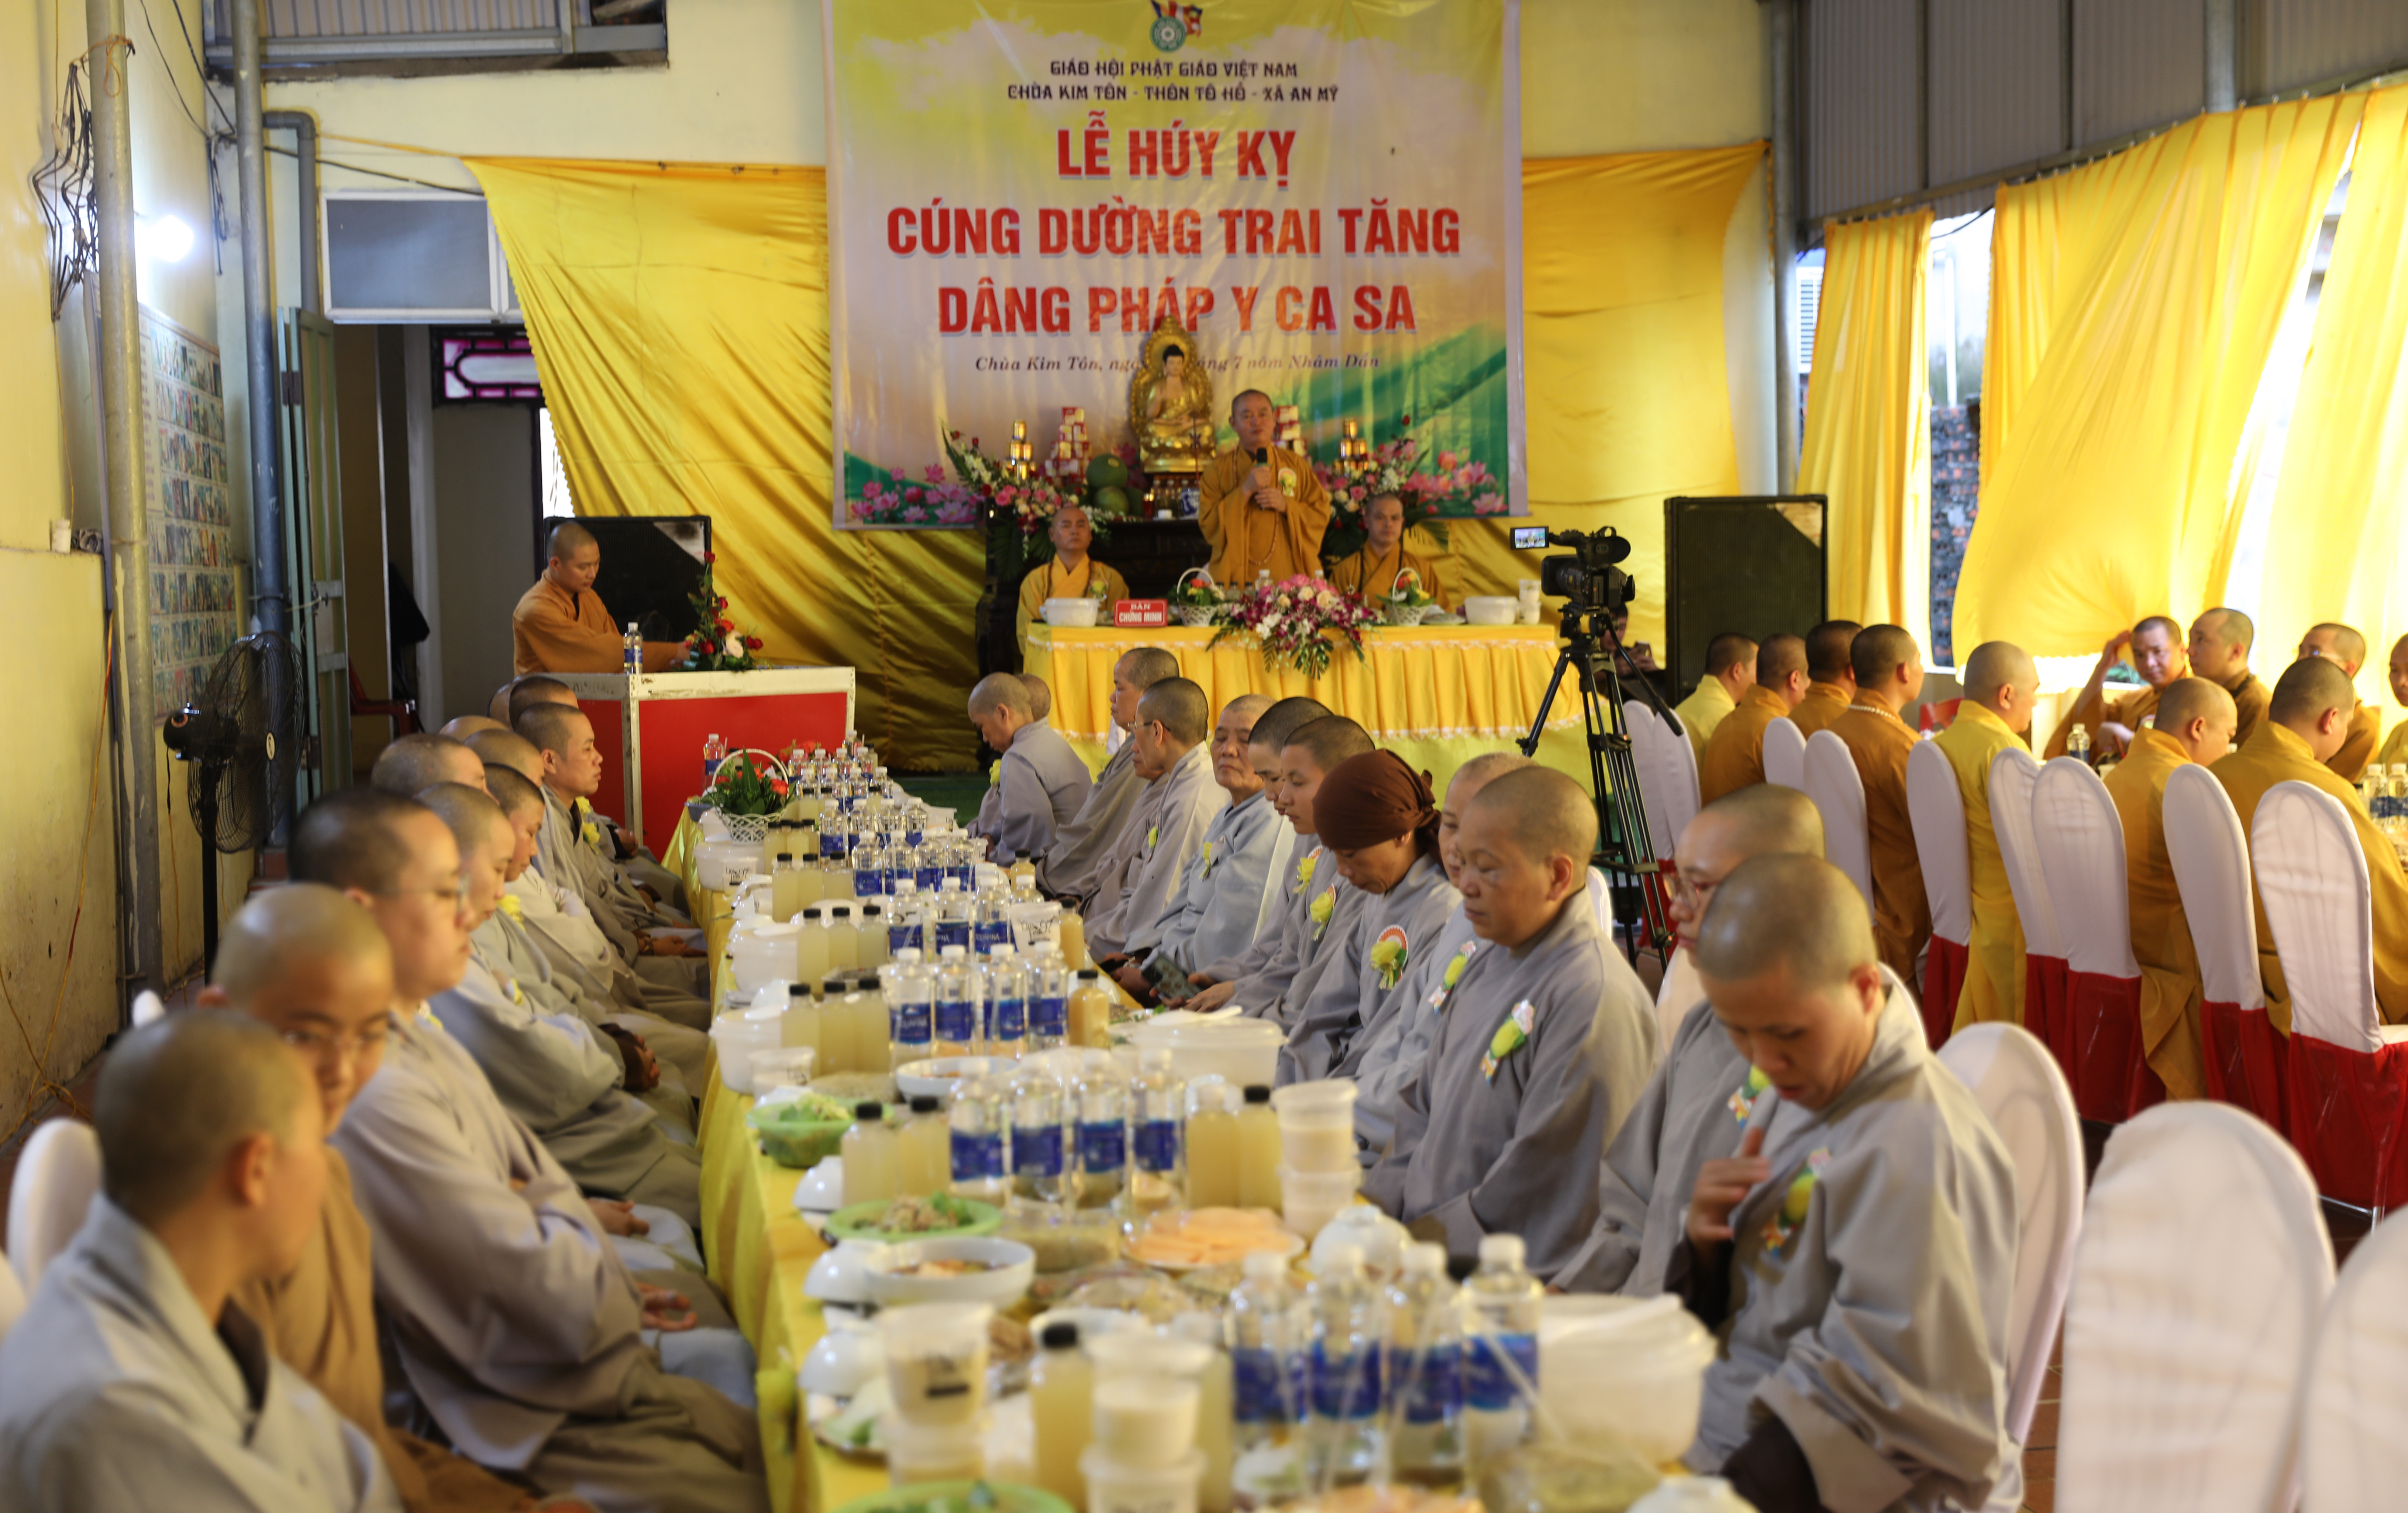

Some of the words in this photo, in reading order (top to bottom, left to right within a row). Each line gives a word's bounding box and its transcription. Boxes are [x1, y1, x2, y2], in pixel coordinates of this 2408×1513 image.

[1050, 58, 1089, 76] GIÁO
[1095, 58, 1124, 78] HỘI
[1130, 58, 1173, 79] PHẬT
[1179, 59, 1217, 76] GIÁO
[1223, 59, 1258, 80] VIỆT
[1264, 63, 1298, 77] NAM
[1008, 81, 1052, 99] CHÙA
[1059, 85, 1088, 100] KIM
[1093, 82, 1126, 100] TÔN
[1144, 82, 1189, 101] THÔN
[1195, 83, 1216, 101] TÔ
[1289, 86, 1311, 101] AN
[1317, 84, 1338, 101] MỸ
[1058, 110, 1110, 176] LỄ
[1129, 120, 1221, 176] HÚY
[1237, 130, 1296, 188] KỴ
[887, 197, 1020, 255] CÚNG
[1039, 195, 1202, 255] DƯỜNG
[1218, 208, 1320, 255] TRAI
[1337, 197, 1460, 254] TĂNG
[938, 276, 1070, 333] DÂNG
[1088, 276, 1214, 332] PHÁP
[1231, 286, 1259, 332] Y
[1275, 285, 1337, 332] CA
[1353, 285, 1416, 331] SA
[975, 356, 1020, 370] Chùa
[1026, 356, 1060, 370] Kim
[1109, 356, 1141, 373] ngà
[1196, 355, 1227, 371] áng
[1234, 356, 1243, 369] 7
[1288, 354, 1338, 369] Nhâm
[1144, 612, 1162, 622] MINH
